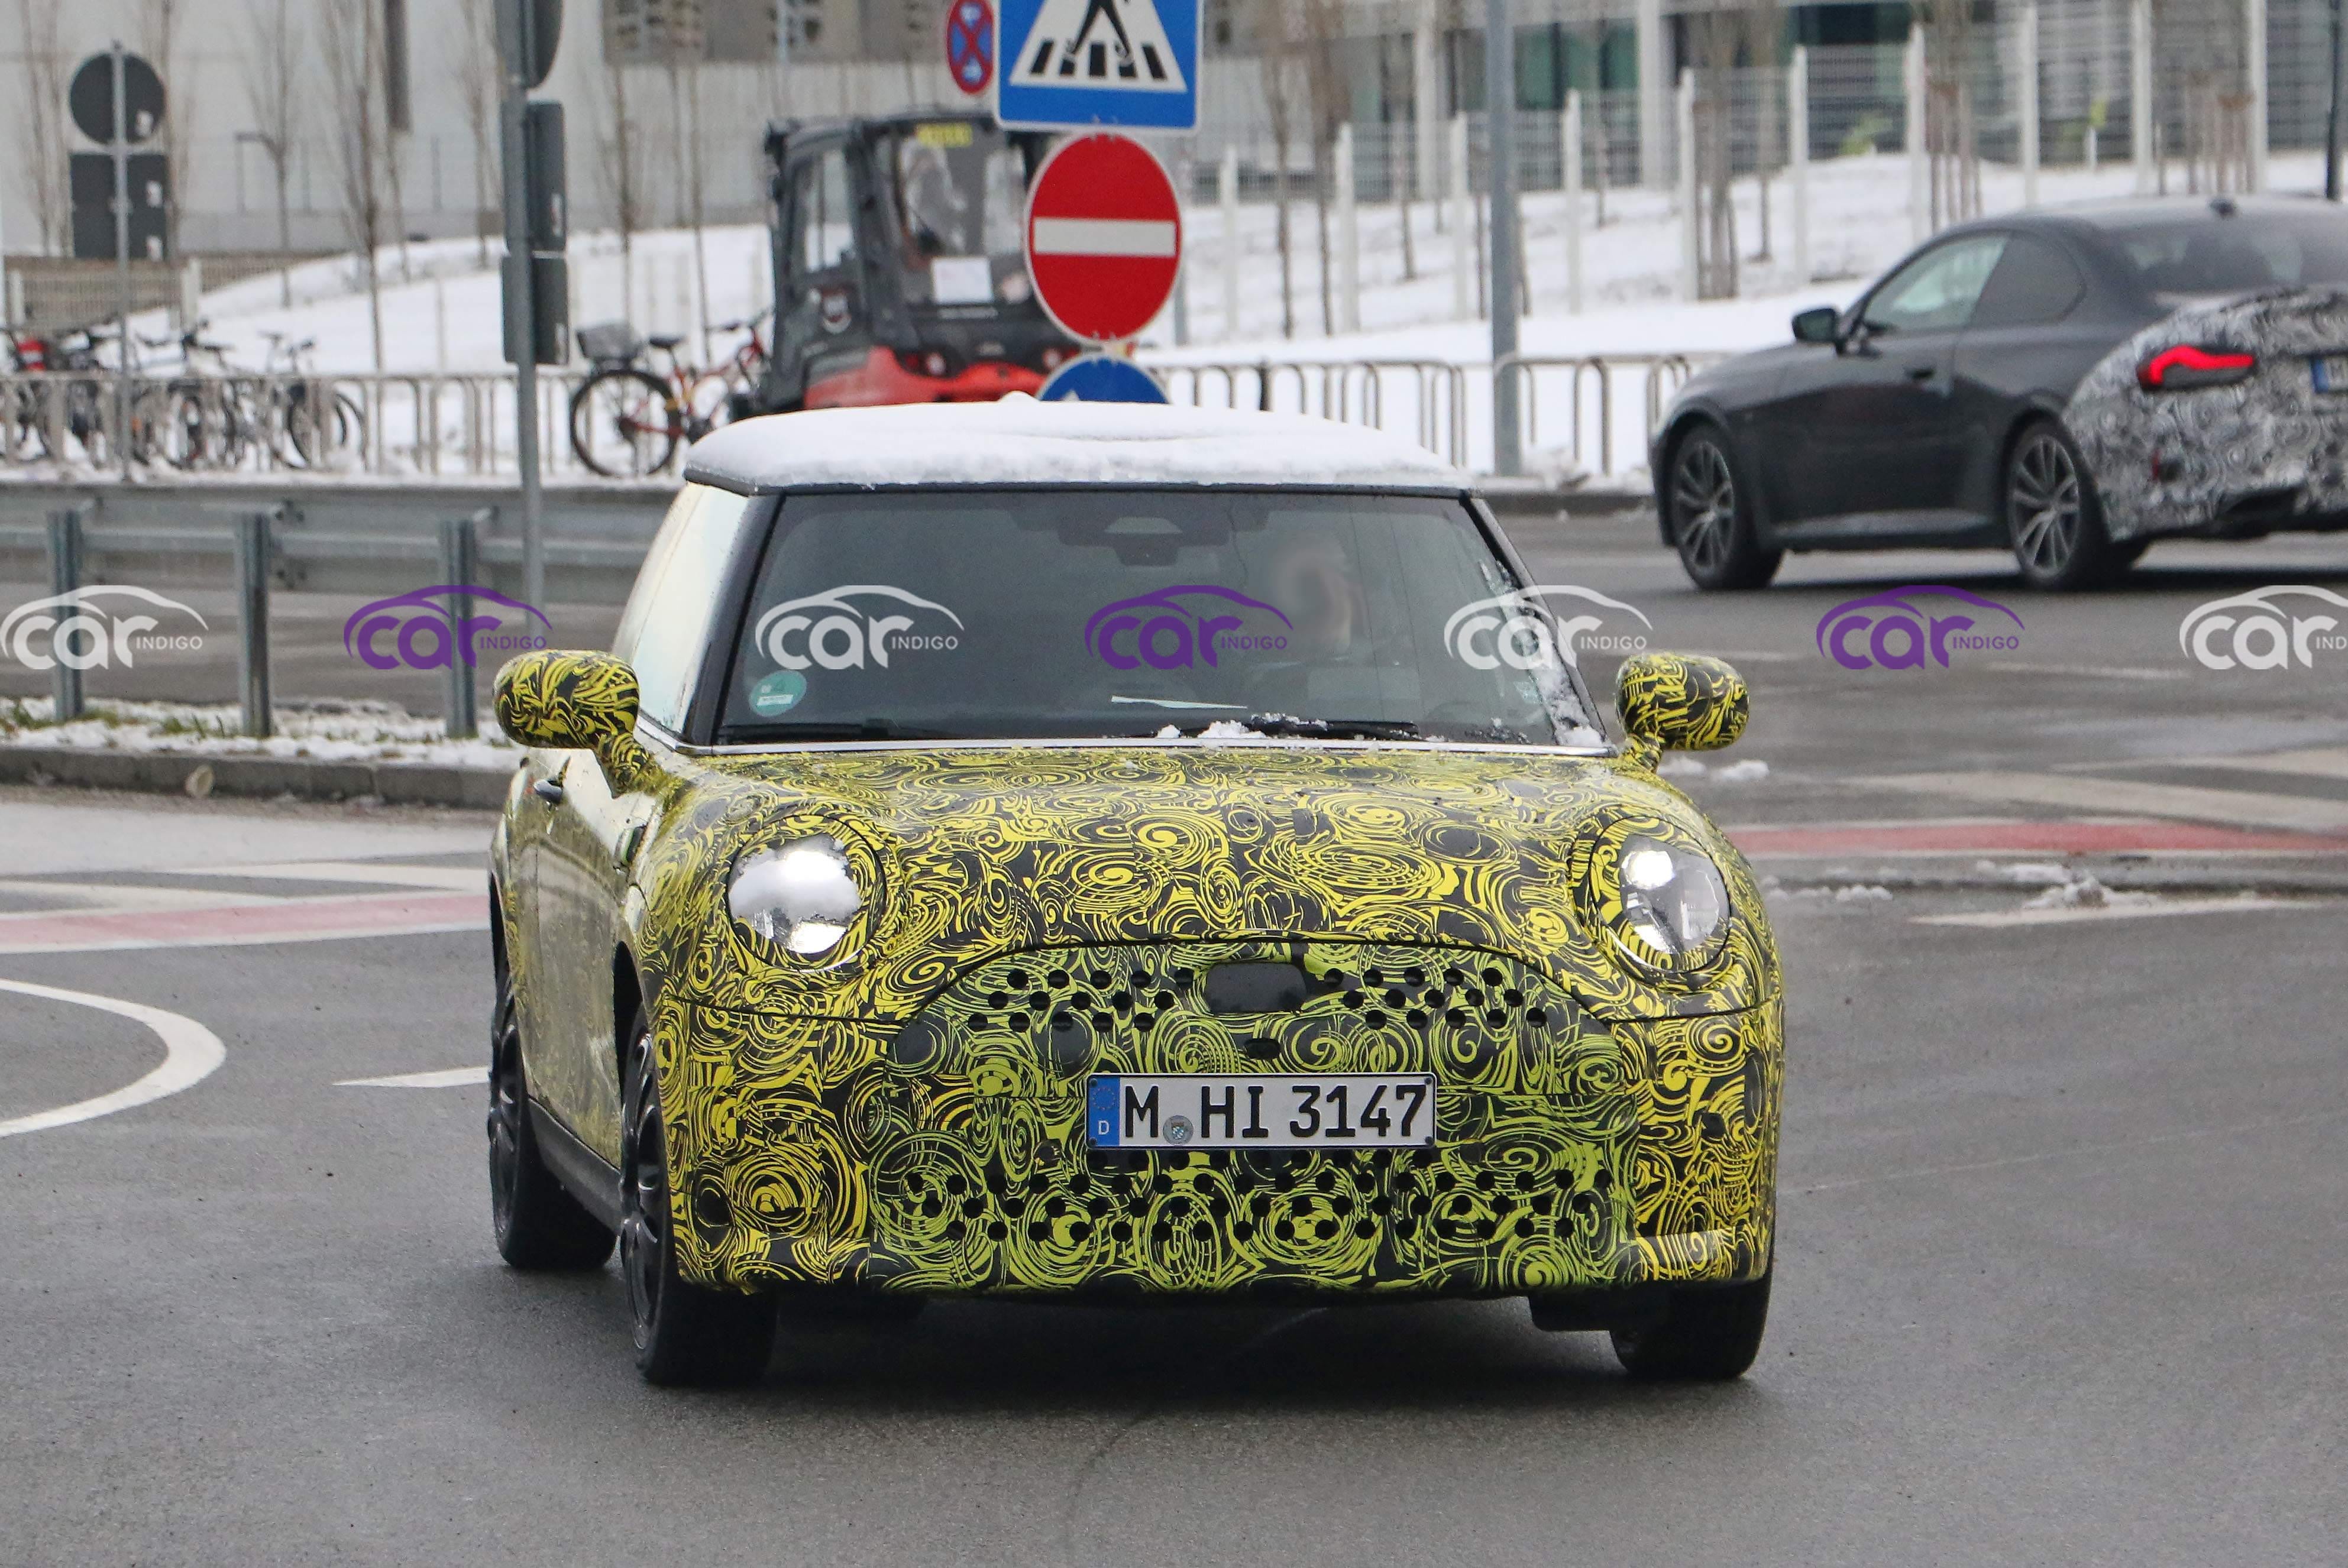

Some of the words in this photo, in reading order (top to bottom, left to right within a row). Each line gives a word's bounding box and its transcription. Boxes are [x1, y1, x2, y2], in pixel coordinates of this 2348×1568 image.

[1098, 1120, 1110, 1135] D
[1126, 1086, 1159, 1138] M
[1201, 1086, 1269, 1138] HI
[1289, 1085, 1427, 1137] 3147
